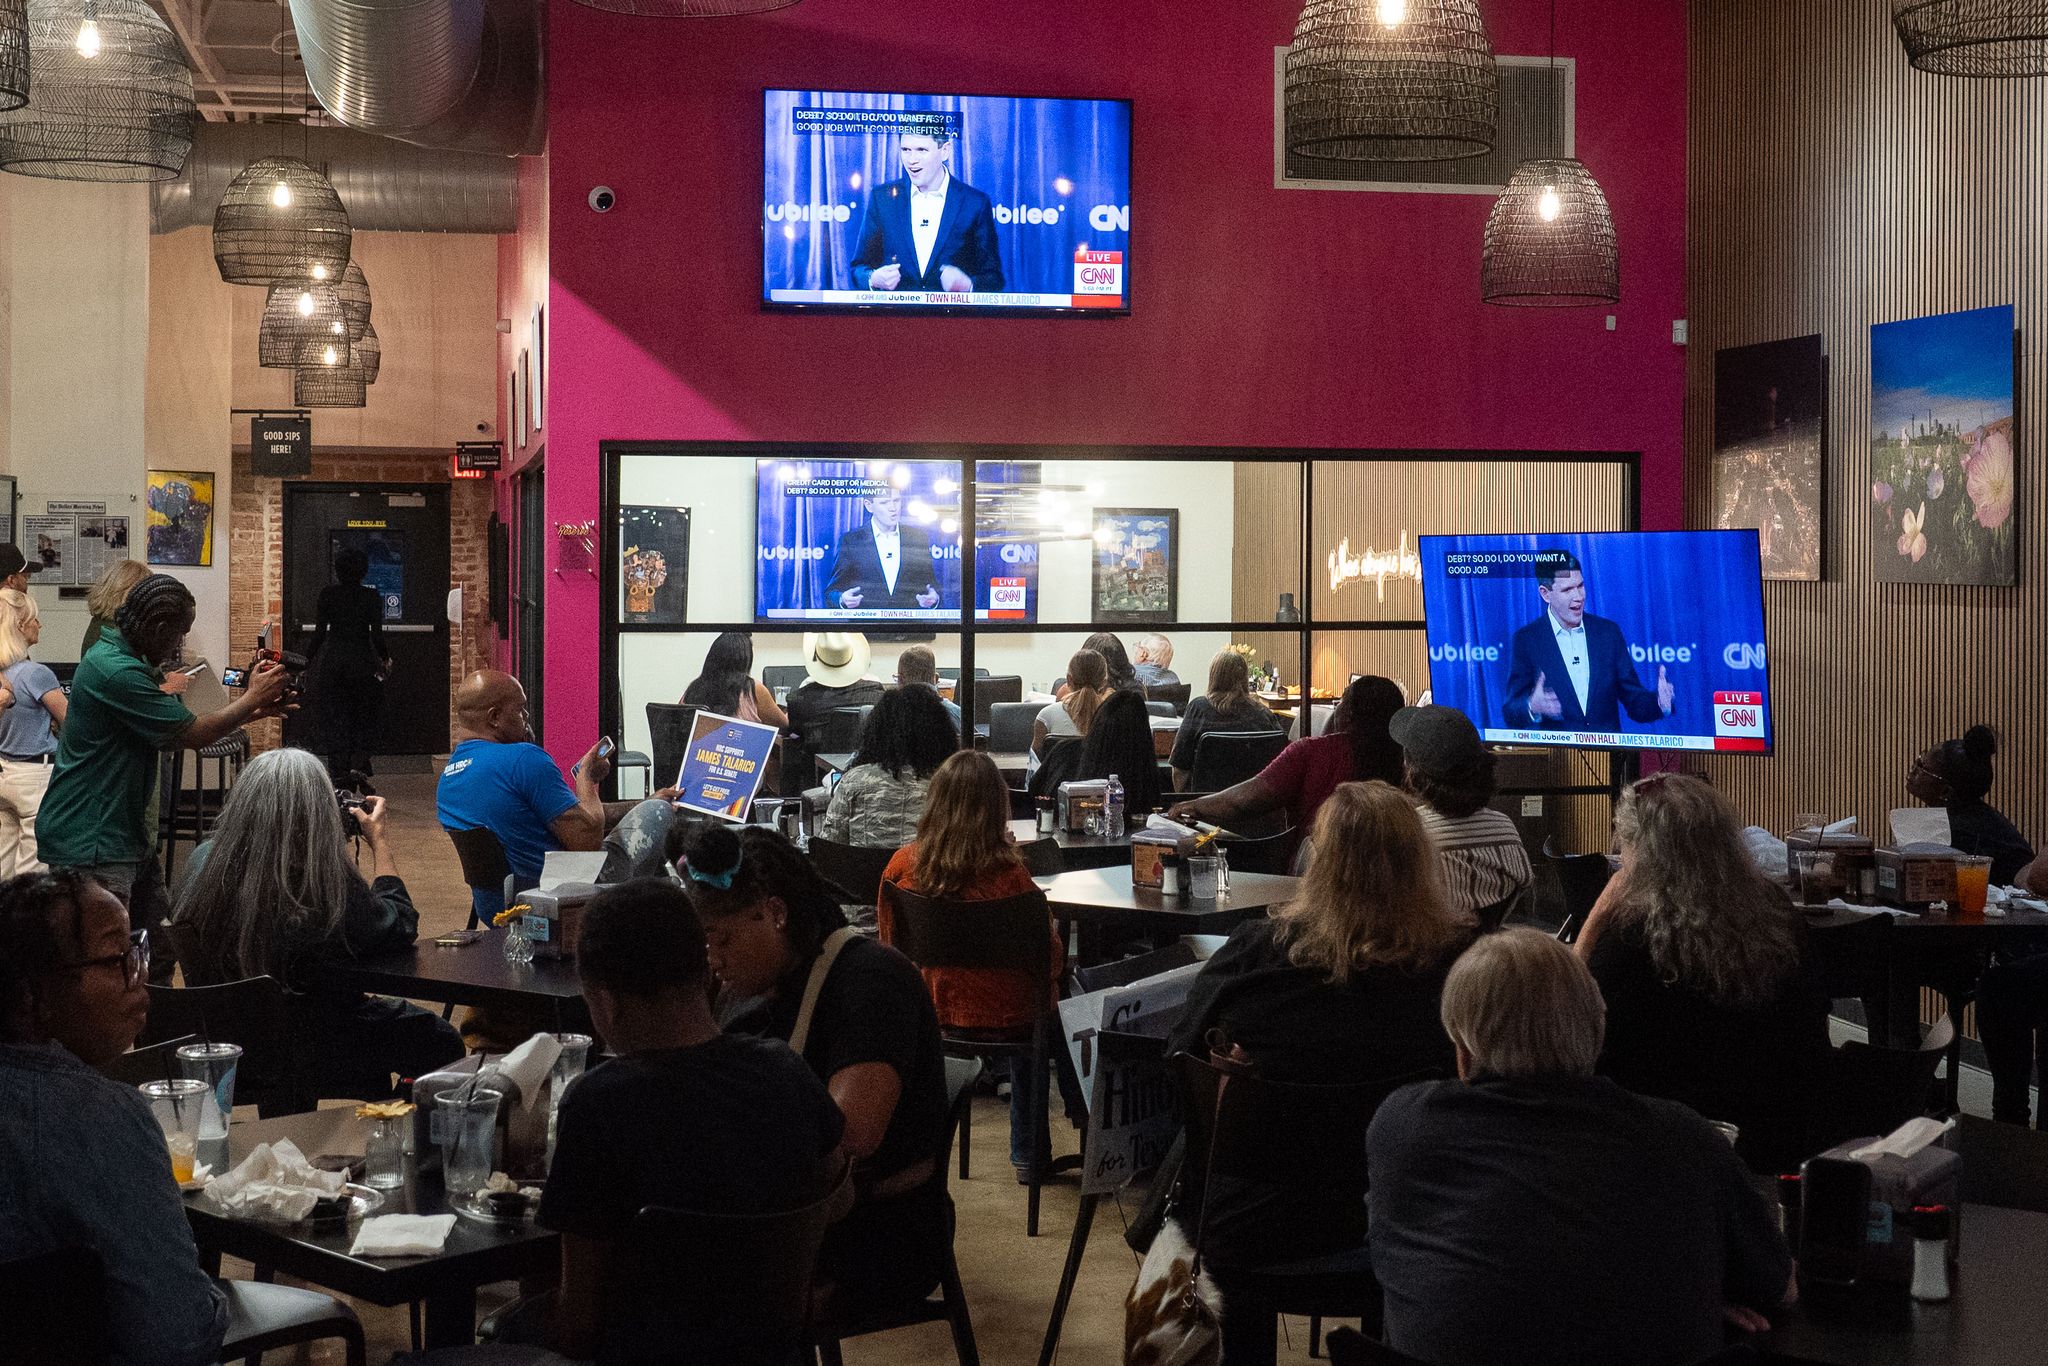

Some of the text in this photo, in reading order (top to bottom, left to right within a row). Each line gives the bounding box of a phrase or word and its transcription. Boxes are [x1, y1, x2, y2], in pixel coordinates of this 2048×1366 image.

[796, 123, 824, 131] GOOD
[825, 123, 843, 132] JOB
[844, 124, 868, 132] WITH
[870, 125, 897, 133] GOOD
[899, 126, 944, 135] BENEFITS?
[992, 203, 1059, 224] bilee
[1085, 253, 1111, 262] LIVE
[1080, 267, 1115, 285] CNN
[888, 294, 920, 302] Jubilee
[925, 293, 949, 303] TOWN
[950, 294, 970, 303] HALL
[972, 294, 1000, 304] JAMES
[1000, 295, 1041, 305] TALARICO
[263, 431, 300, 441] GOOD SIPS
[270, 444, 291, 454] HERE!
[1447, 554, 1471, 563] DEBT?
[1472, 554, 1484, 563] SO
[1485, 554, 1497, 563] DO
[1503, 554, 1516, 562] DO
[1516, 554, 1533, 562] YOU
[1534, 553, 1559, 562] WANT
[1559, 553, 1566, 562] A
[1447, 566, 1489, 574] GOOD JOB
[994, 589, 1021, 602] CNN
[880, 610, 898, 618] TOWN
[1627, 643, 1691, 663] bilee
[1725, 693, 1750, 703] LIVE
[1721, 708, 1756, 727] CNN
[1541, 733, 1571, 742] Jubilee
[1574, 733, 1597, 743] TOWN
[1598, 735, 1617, 744] HALL
[1618, 735, 1645, 746] JAMES
[1645, 736, 1684, 747] TALARICO
[724, 745, 745, 757] SUPPORTS
[695, 748, 756, 774] JAMES TALARICO
[1097, 1151, 1126, 1177] for
